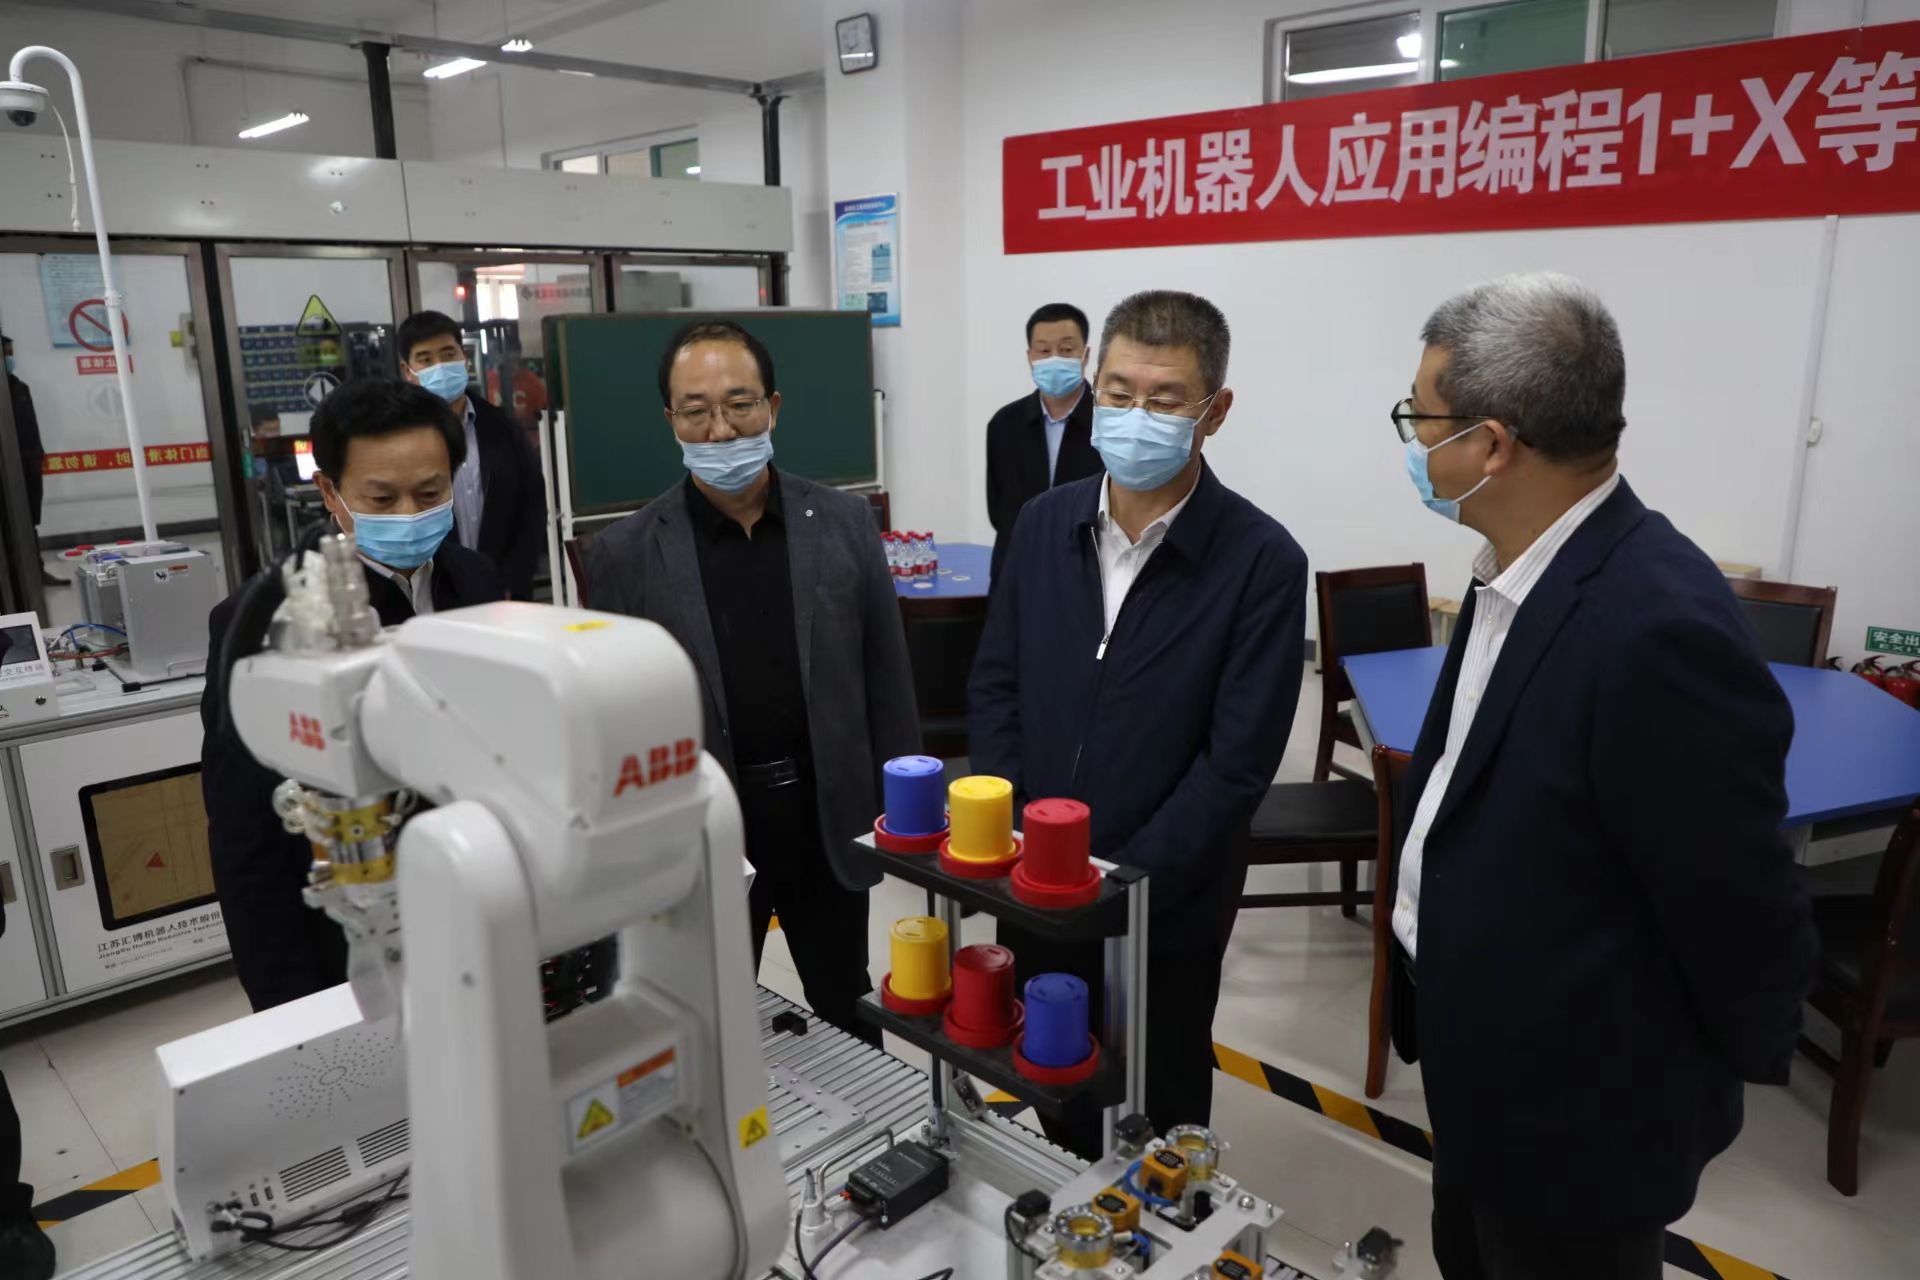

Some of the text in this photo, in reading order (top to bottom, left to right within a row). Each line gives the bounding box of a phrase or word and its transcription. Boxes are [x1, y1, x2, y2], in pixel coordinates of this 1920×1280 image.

[1038, 51, 1920, 221] 工业机器人应用编程1+X等
[613, 737, 699, 797] ABB
